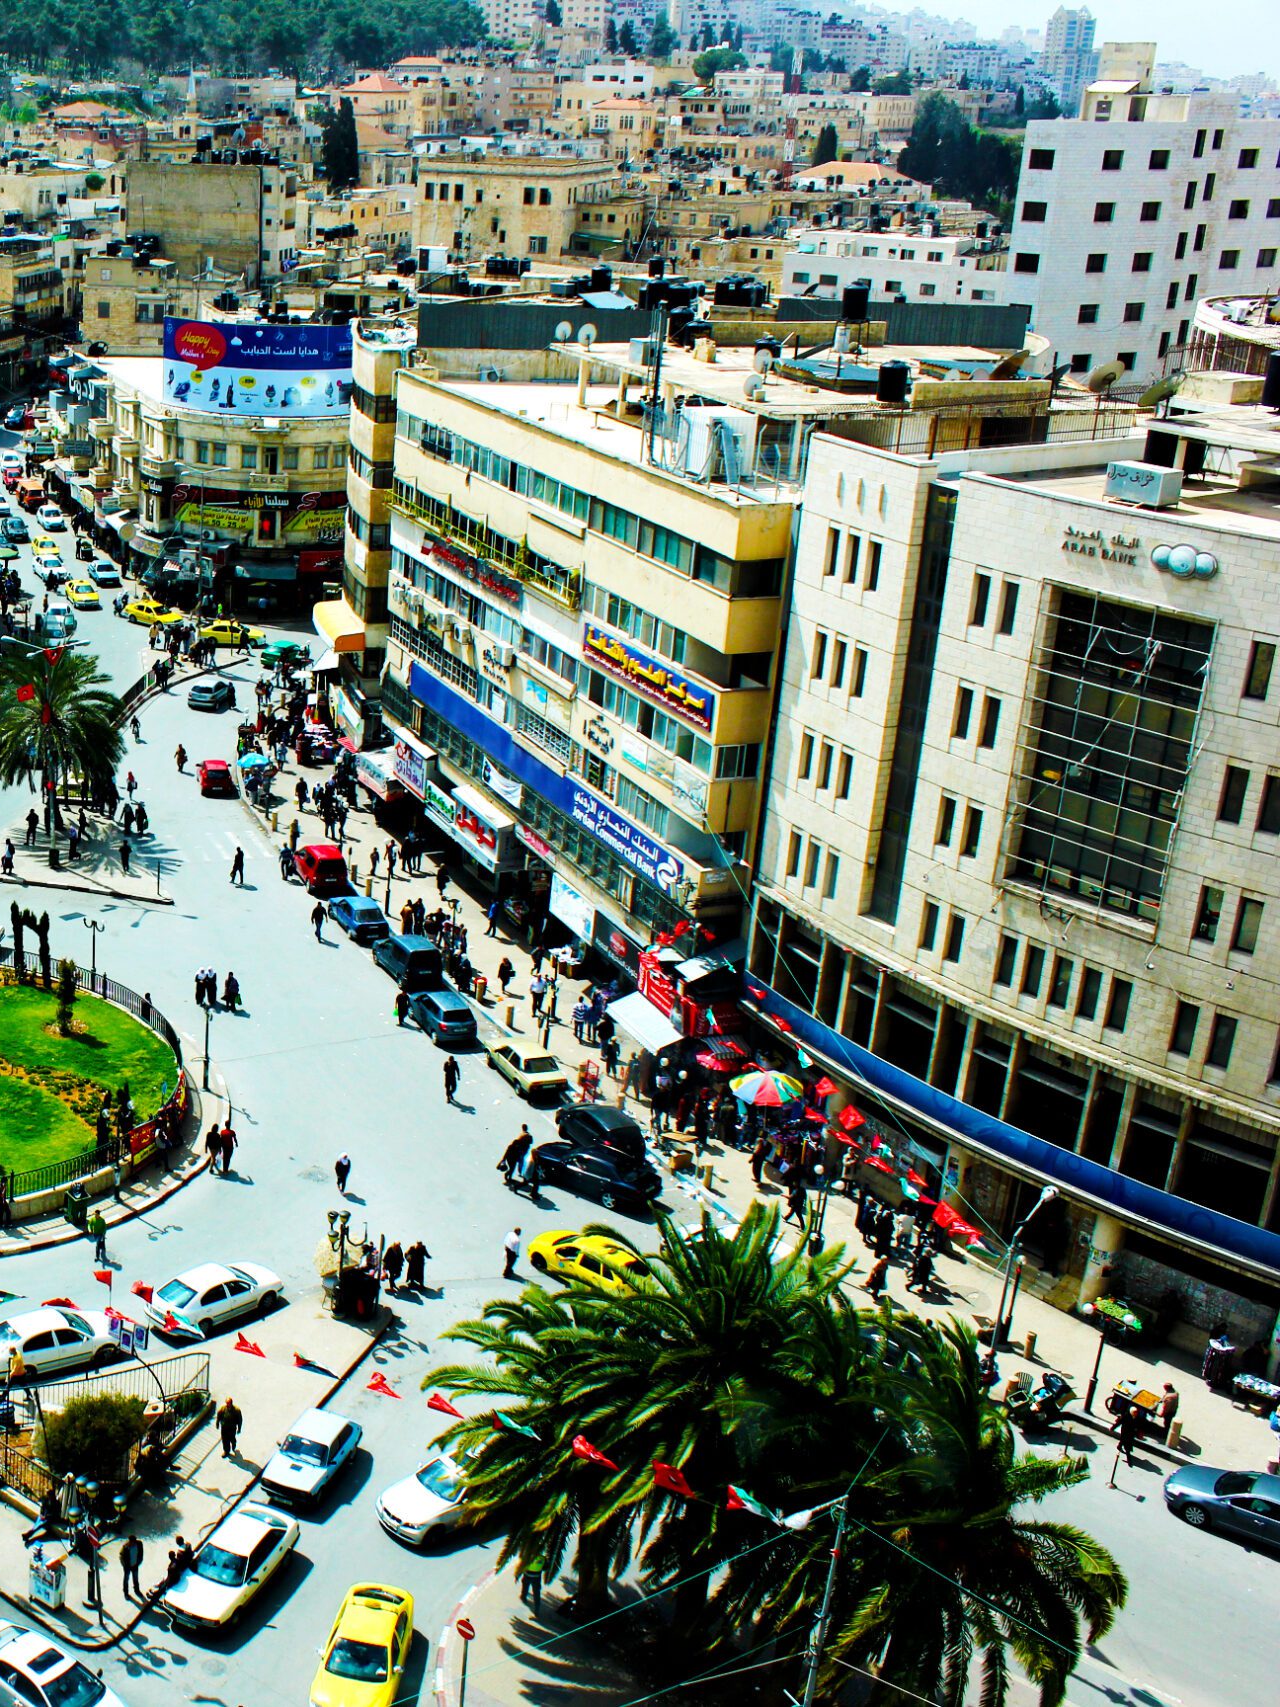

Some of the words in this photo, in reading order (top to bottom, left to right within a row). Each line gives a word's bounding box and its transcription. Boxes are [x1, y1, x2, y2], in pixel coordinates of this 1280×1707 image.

[181, 330, 211, 349] Happy
[240, 346, 271, 357] الحبايب
[272, 346, 296, 356] لست
[298, 346, 319, 358] هدايا
[264, 495, 289, 508] سيلينا
[1063, 525, 1104, 548] العربي
[1110, 534, 1139, 549] البنك
[1061, 540, 1096, 557] ARAB
[1101, 549, 1137, 566] BANK
[585, 626, 630, 670] والثقافة
[627, 658, 667, 687] العلوم
[664, 673, 706, 709] مركز
[573, 791, 597, 815] الأردني
[597, 810, 631, 840] التجاري
[572, 806, 595, 832] Jordan
[595, 824, 637, 865] Commercial
[636, 855, 657, 880] Bank
[631, 836, 659, 861] البنك
